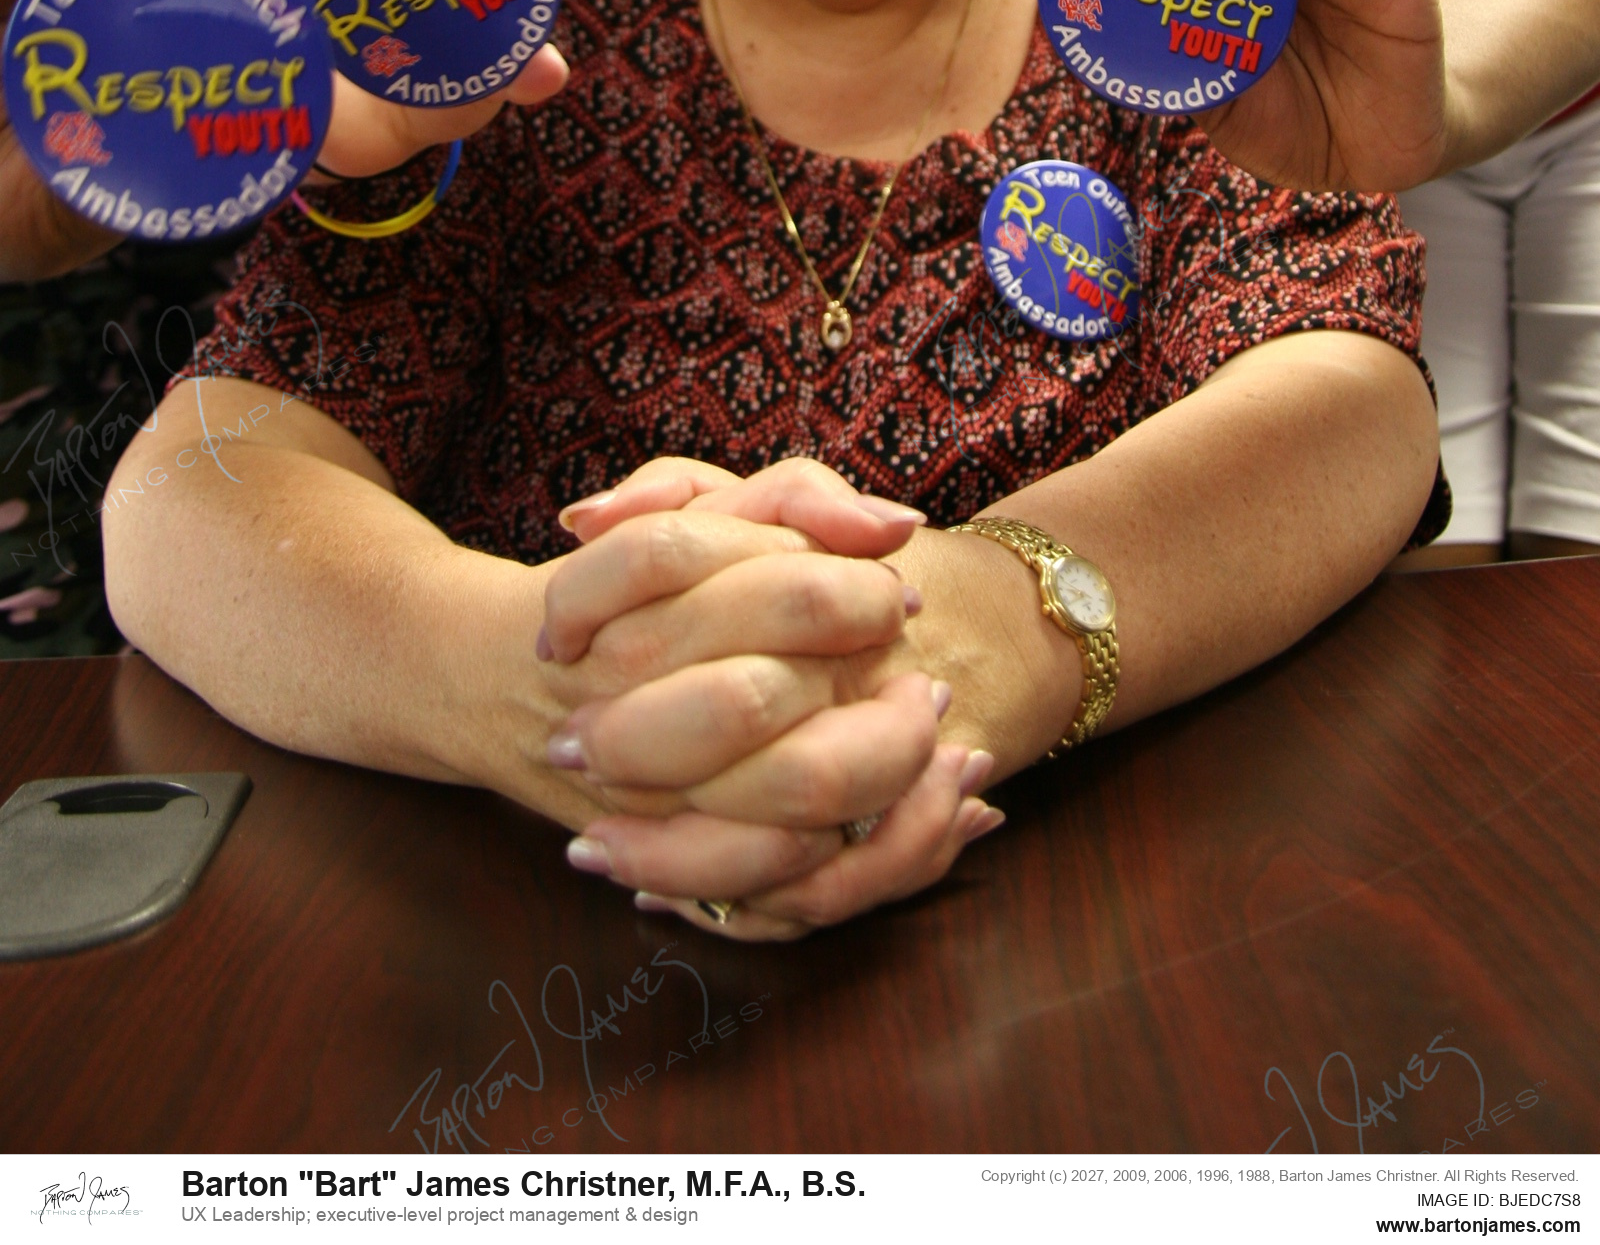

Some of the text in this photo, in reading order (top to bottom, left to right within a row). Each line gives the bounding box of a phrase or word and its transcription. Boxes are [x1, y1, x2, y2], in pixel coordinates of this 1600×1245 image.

[1052, 24, 1237, 110] Ambassador
[1168, 19, 1262, 74] YOUTH
[186, 107, 312, 159] YOUTH
[52, 149, 298, 240] Ambassador
[1022, 168, 1080, 189] Teen
[987, 246, 1109, 337] Ambassador
[1067, 268, 1128, 324] YOUTH
